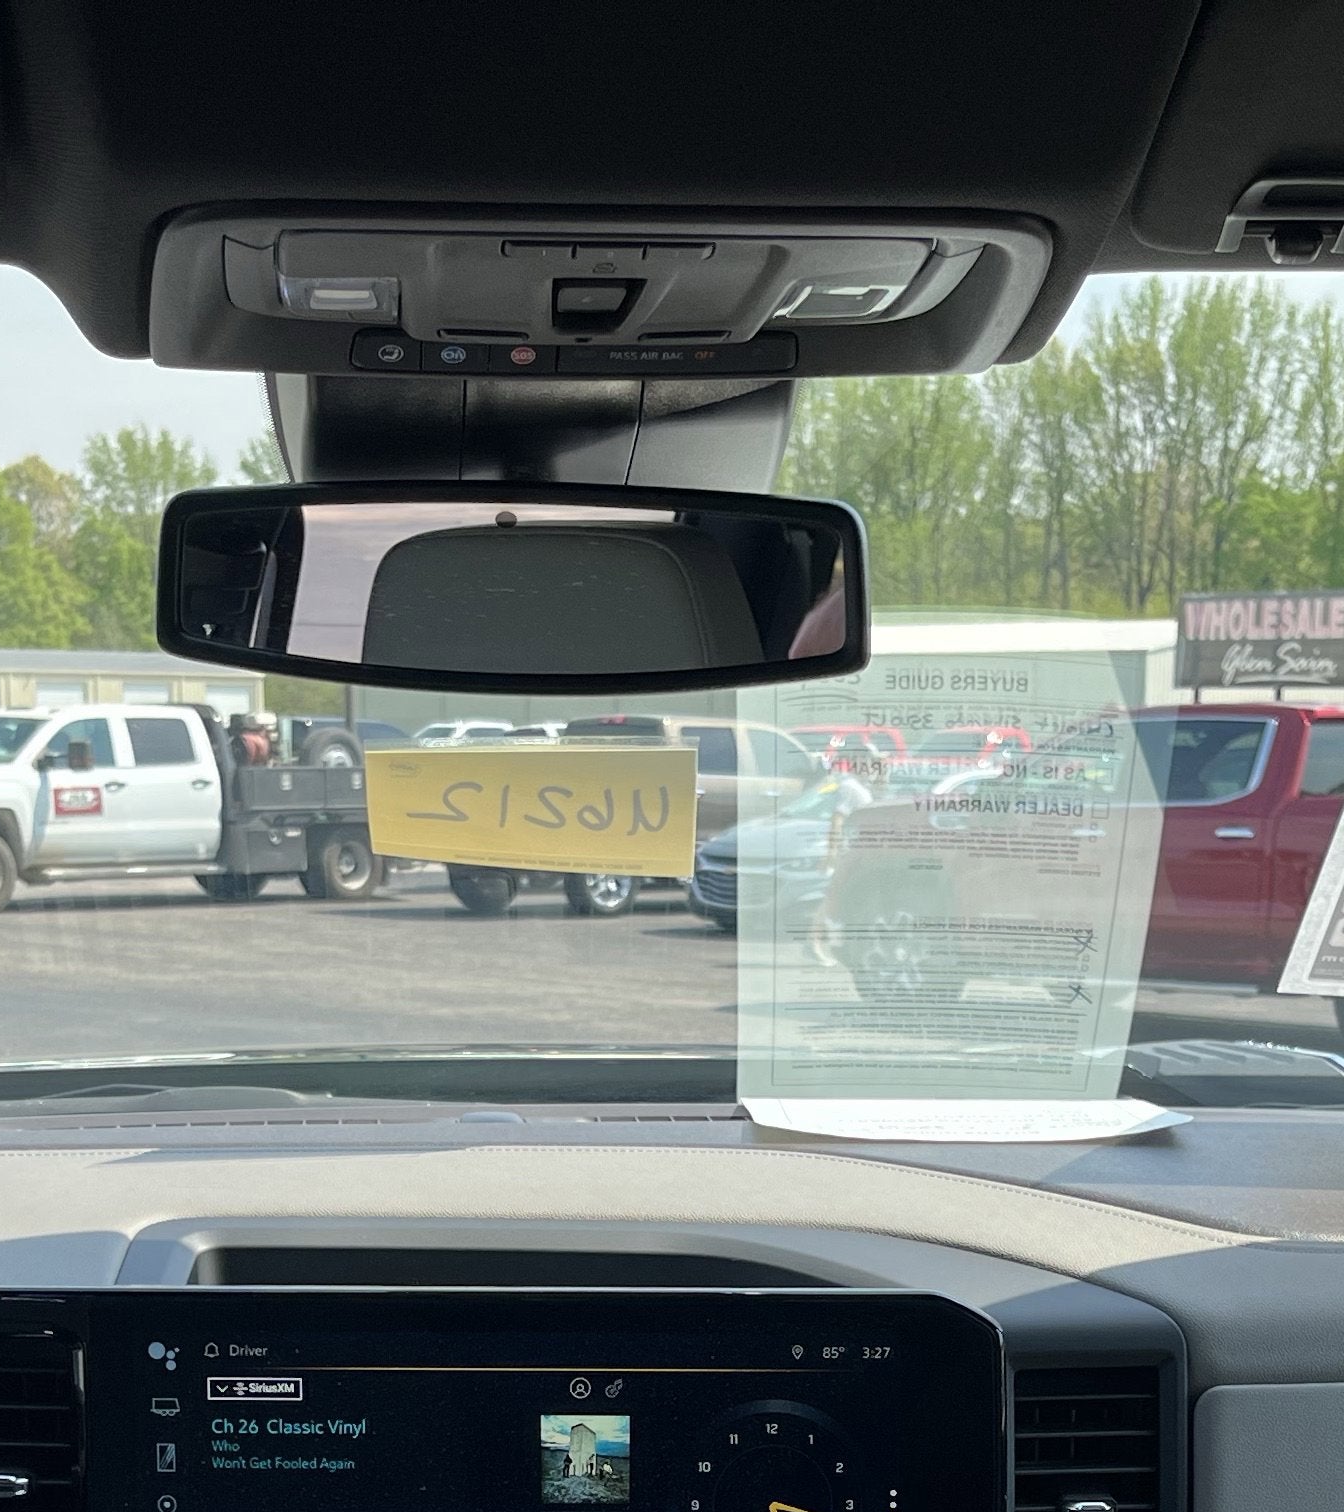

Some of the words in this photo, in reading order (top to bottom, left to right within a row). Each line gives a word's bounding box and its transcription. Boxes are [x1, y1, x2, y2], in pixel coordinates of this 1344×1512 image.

[513, 350, 534, 360] SOS
[609, 352, 638, 361] PASS
[640, 352, 659, 361] AIR
[661, 352, 683, 361] BAG
[229, 1344, 268, 1357] Driver
[822, 1346, 846, 1359] 85°
[862, 1347, 891, 1359] 3:27
[248, 1382, 295, 1394] SiriusXM
[211, 1419, 234, 1435] Ch
[238, 1419, 259, 1435] 26
[267, 1418, 324, 1435] Classic
[327, 1418, 366, 1439] Vinyl
[765, 1424, 778, 1434] 12
[729, 1434, 739, 1445] 11
[211, 1440, 240, 1452] Who
[211, 1457, 247, 1469] Won't
[249, 1457, 272, 1469] Get
[275, 1457, 317, 1470] Fooled
[320, 1457, 355, 1472] Again
[698, 1462, 711, 1473] 10
[836, 1463, 844, 1473] 2
[691, 1500, 700, 1511] 9
[845, 1500, 854, 1511] 3
